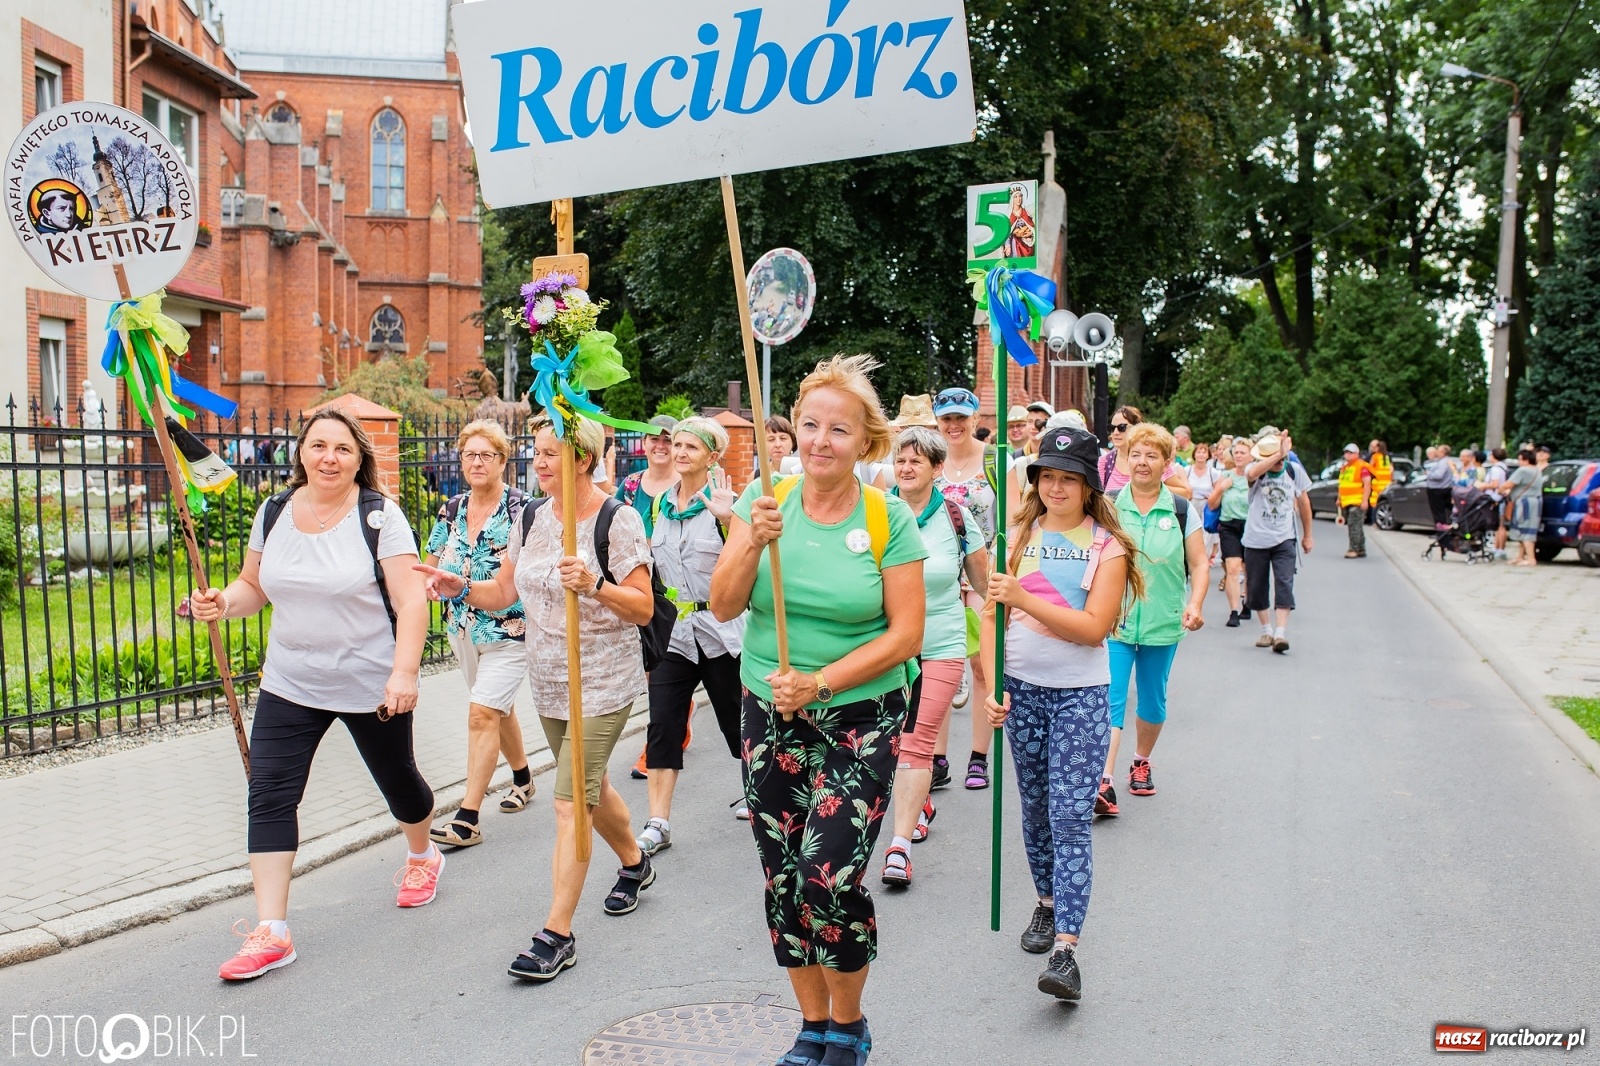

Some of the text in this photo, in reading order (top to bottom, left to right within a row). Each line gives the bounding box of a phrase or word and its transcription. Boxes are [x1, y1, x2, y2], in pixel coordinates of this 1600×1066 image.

[489, 0, 958, 153] Racibórz
[10, 110, 193, 242] PARAFIA ŚWIĘTEGO TOMASZA APOSTOŁA
[46, 222, 181, 266] KIETRZ
[973, 187, 1012, 258] 5
[1023, 545, 1093, 560] H YEAH
